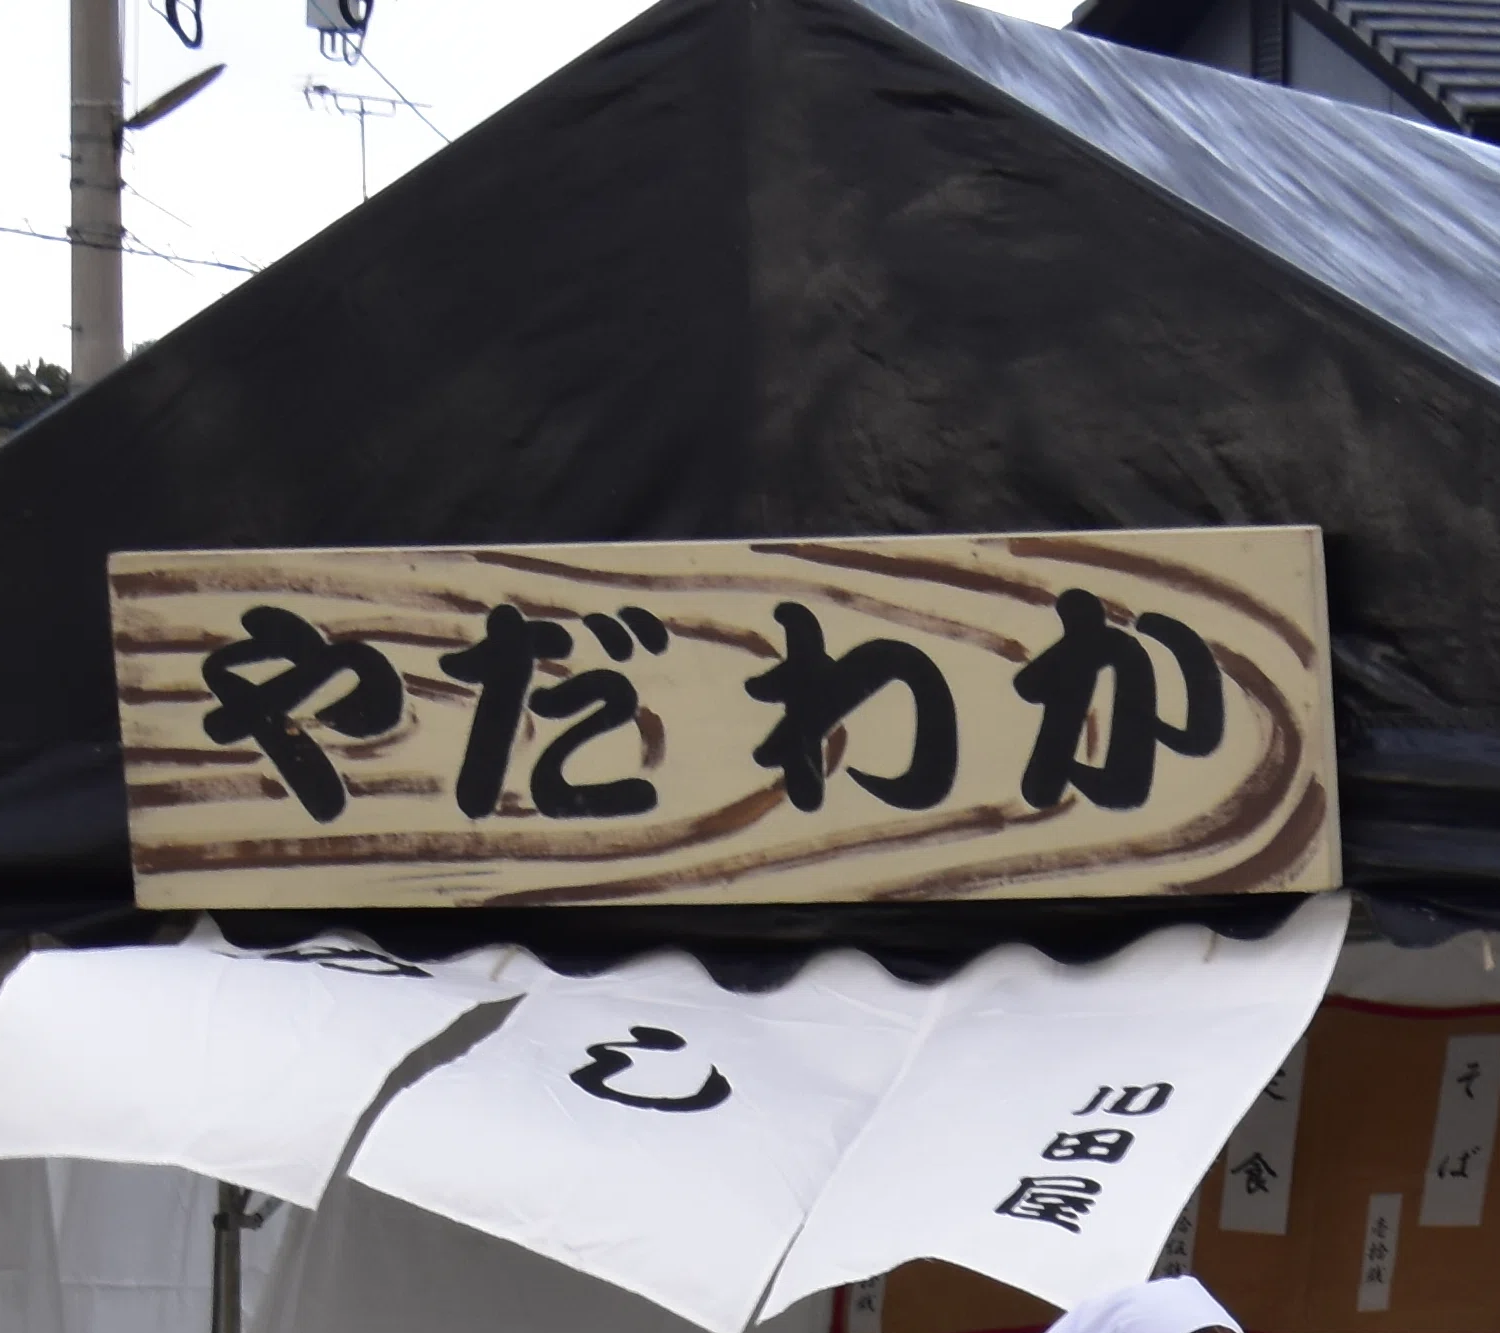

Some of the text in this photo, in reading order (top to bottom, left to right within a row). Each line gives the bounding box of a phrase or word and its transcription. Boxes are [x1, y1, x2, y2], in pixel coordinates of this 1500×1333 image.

[994, 1082, 1174, 1234] 川田屋
[1437, 1061, 1482, 1183] そば
